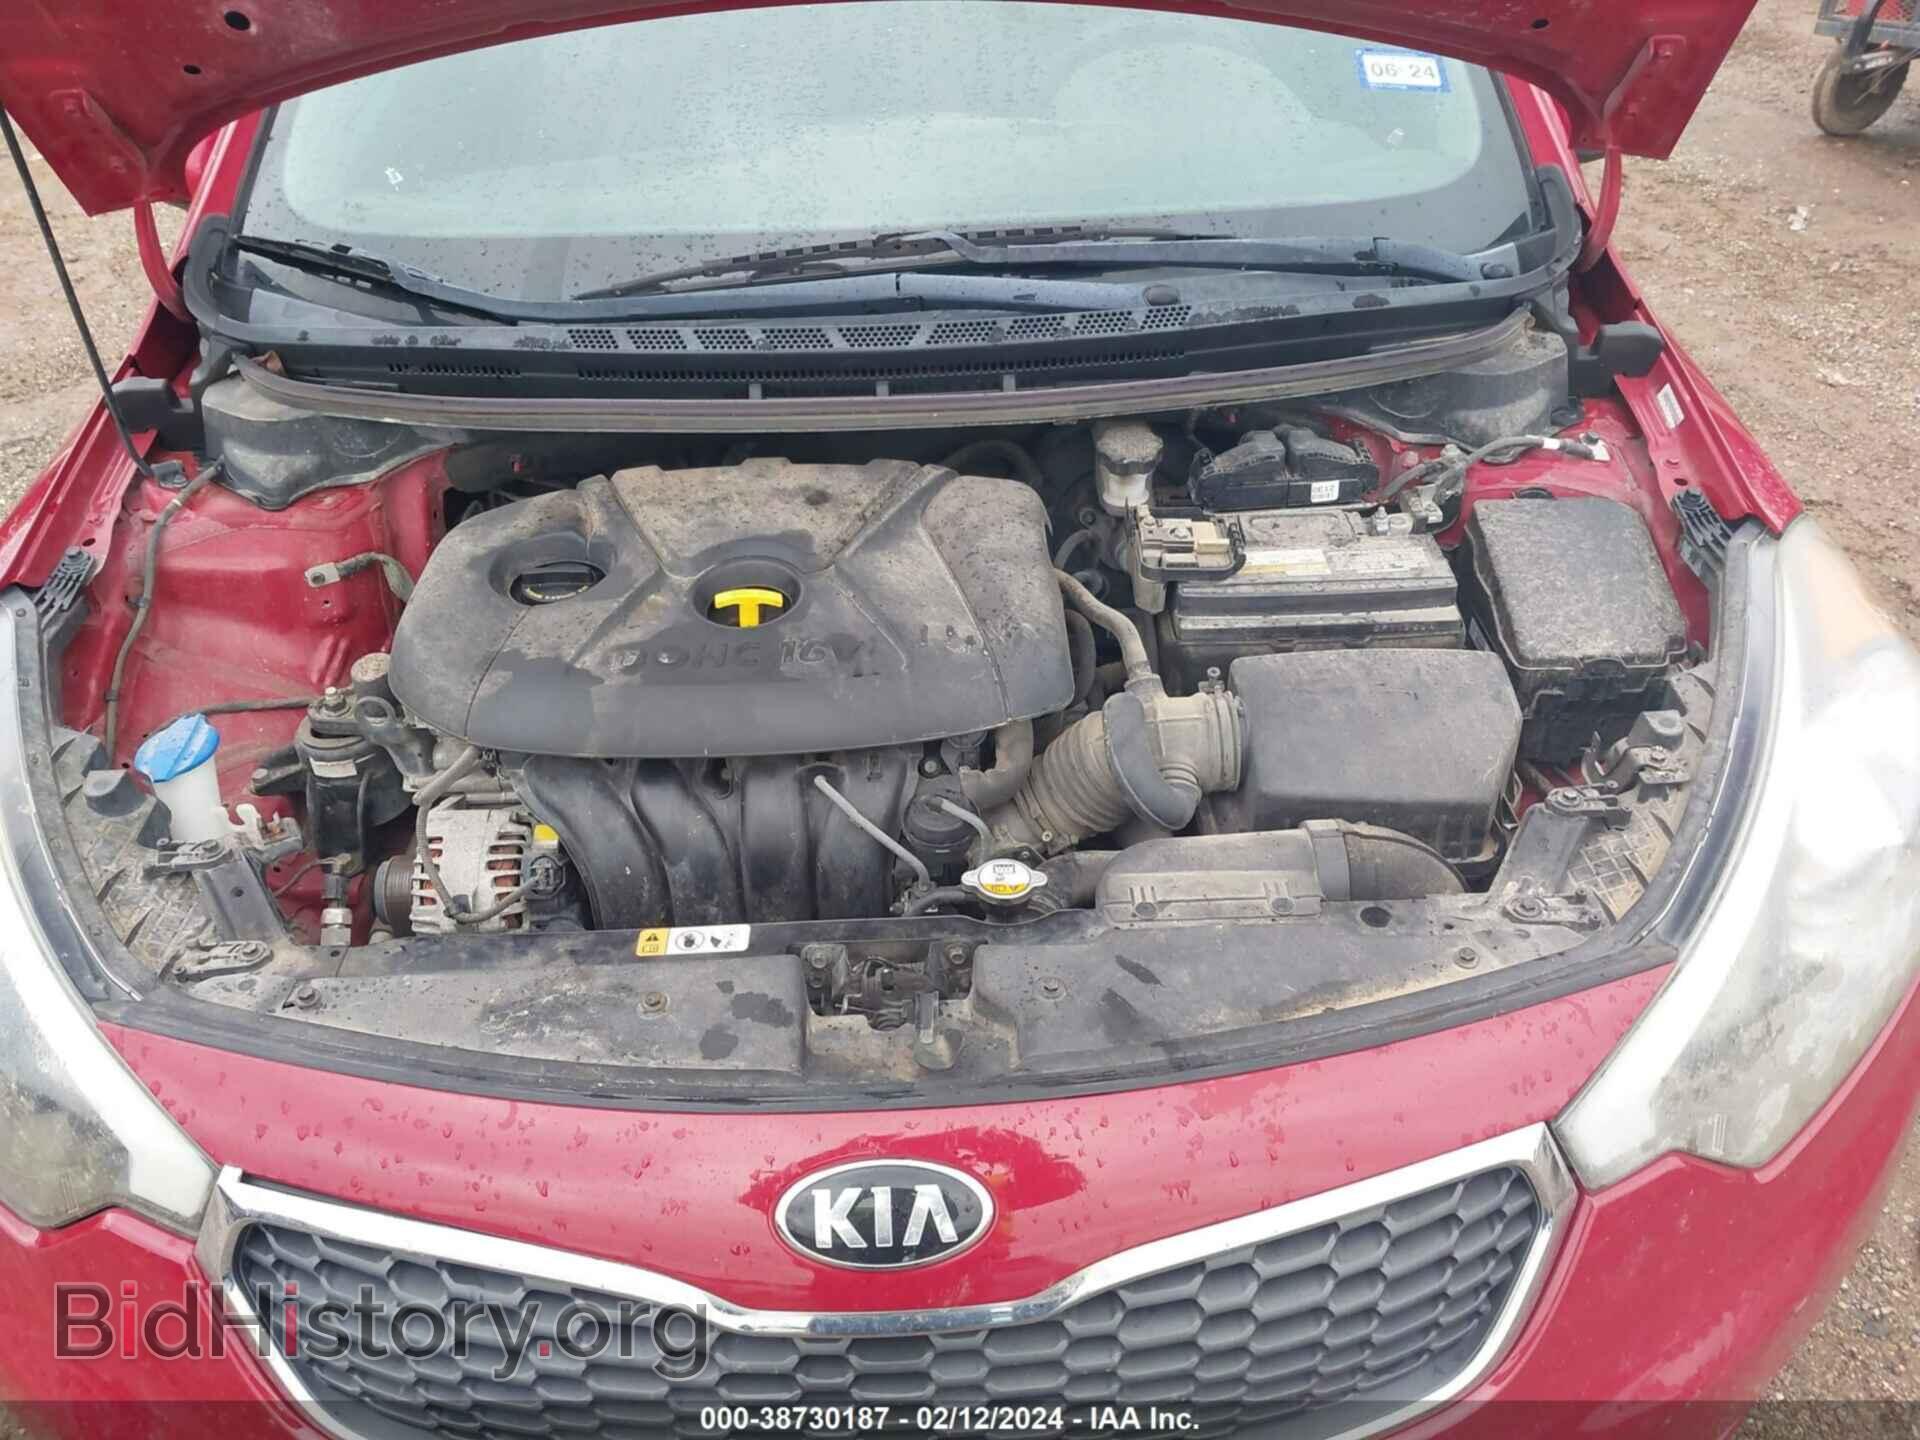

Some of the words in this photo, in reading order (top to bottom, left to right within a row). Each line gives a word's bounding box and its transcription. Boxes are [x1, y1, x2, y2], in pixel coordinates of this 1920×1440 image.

[1370, 62, 1397, 78] 06
[1408, 63, 1435, 79] 24
[811, 1184, 960, 1249] KIA
